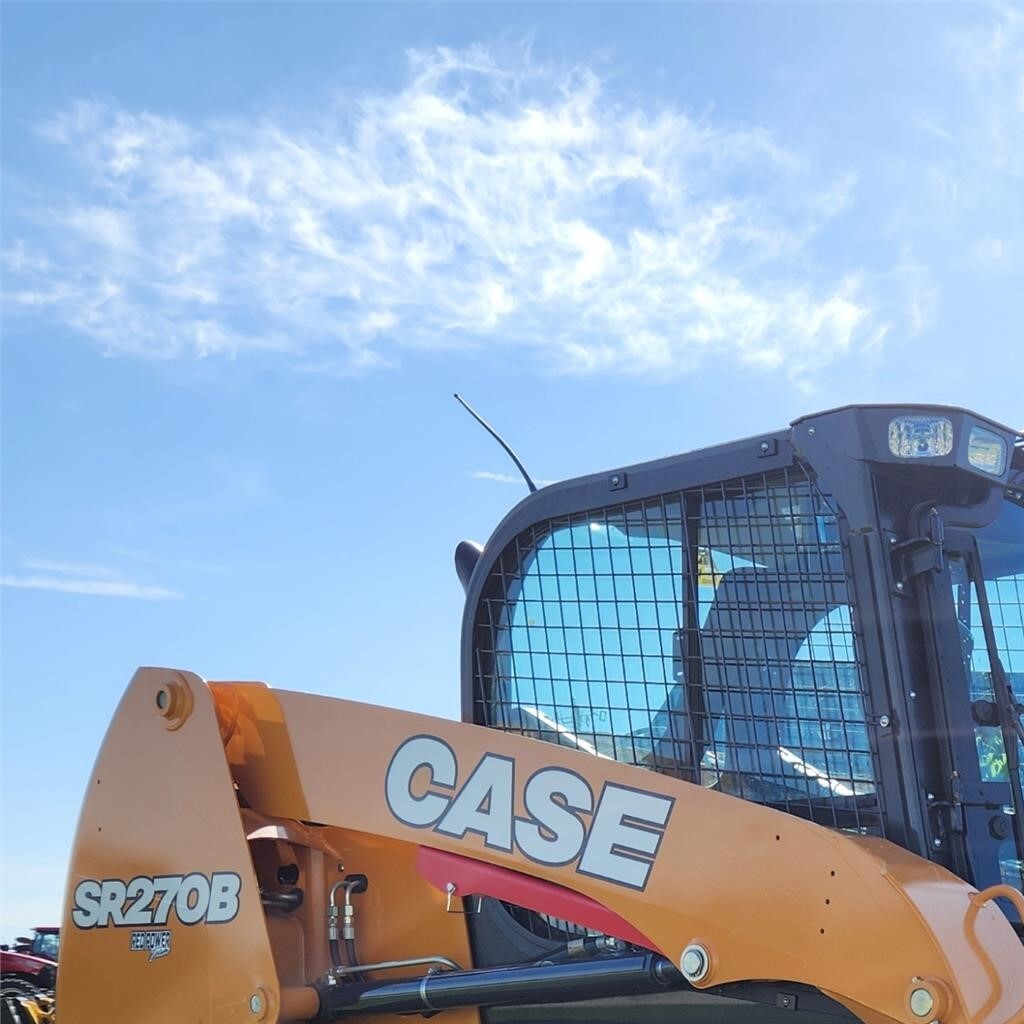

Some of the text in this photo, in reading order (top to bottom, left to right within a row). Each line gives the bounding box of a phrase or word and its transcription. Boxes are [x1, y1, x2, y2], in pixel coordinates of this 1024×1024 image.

[385, 734, 676, 892] CASE
[72, 872, 242, 929] SR270B
[131, 931, 145, 950] RED
